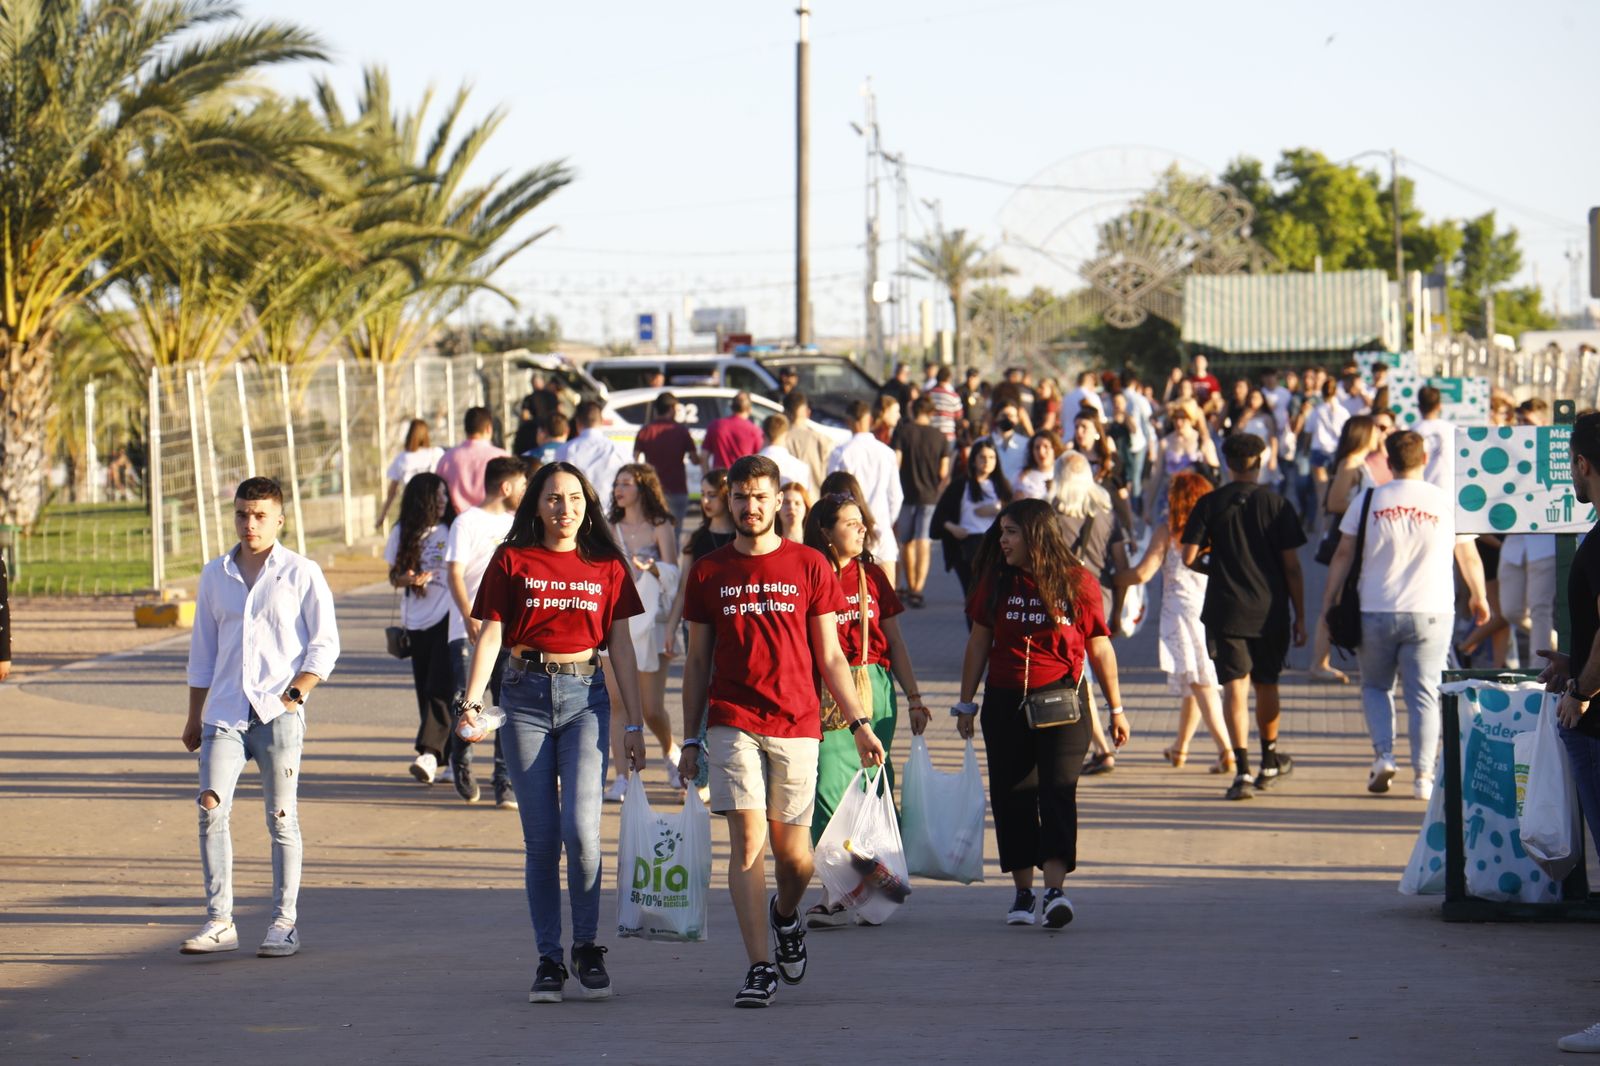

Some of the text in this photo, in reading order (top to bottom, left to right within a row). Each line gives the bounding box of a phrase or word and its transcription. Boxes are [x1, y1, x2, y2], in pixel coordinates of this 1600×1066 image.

[1549, 441, 1570, 451] pap
[1549, 452, 1569, 461] que
[1549, 460, 1571, 470] luna
[525, 577, 602, 595] Hoy no salgo,
[720, 581, 799, 598] Hoy no salgo,
[526, 597, 598, 612] es pegriloso
[1007, 595, 1025, 607] Hoy
[723, 599, 795, 616] es pegriloso
[1006, 611, 1019, 620] es
